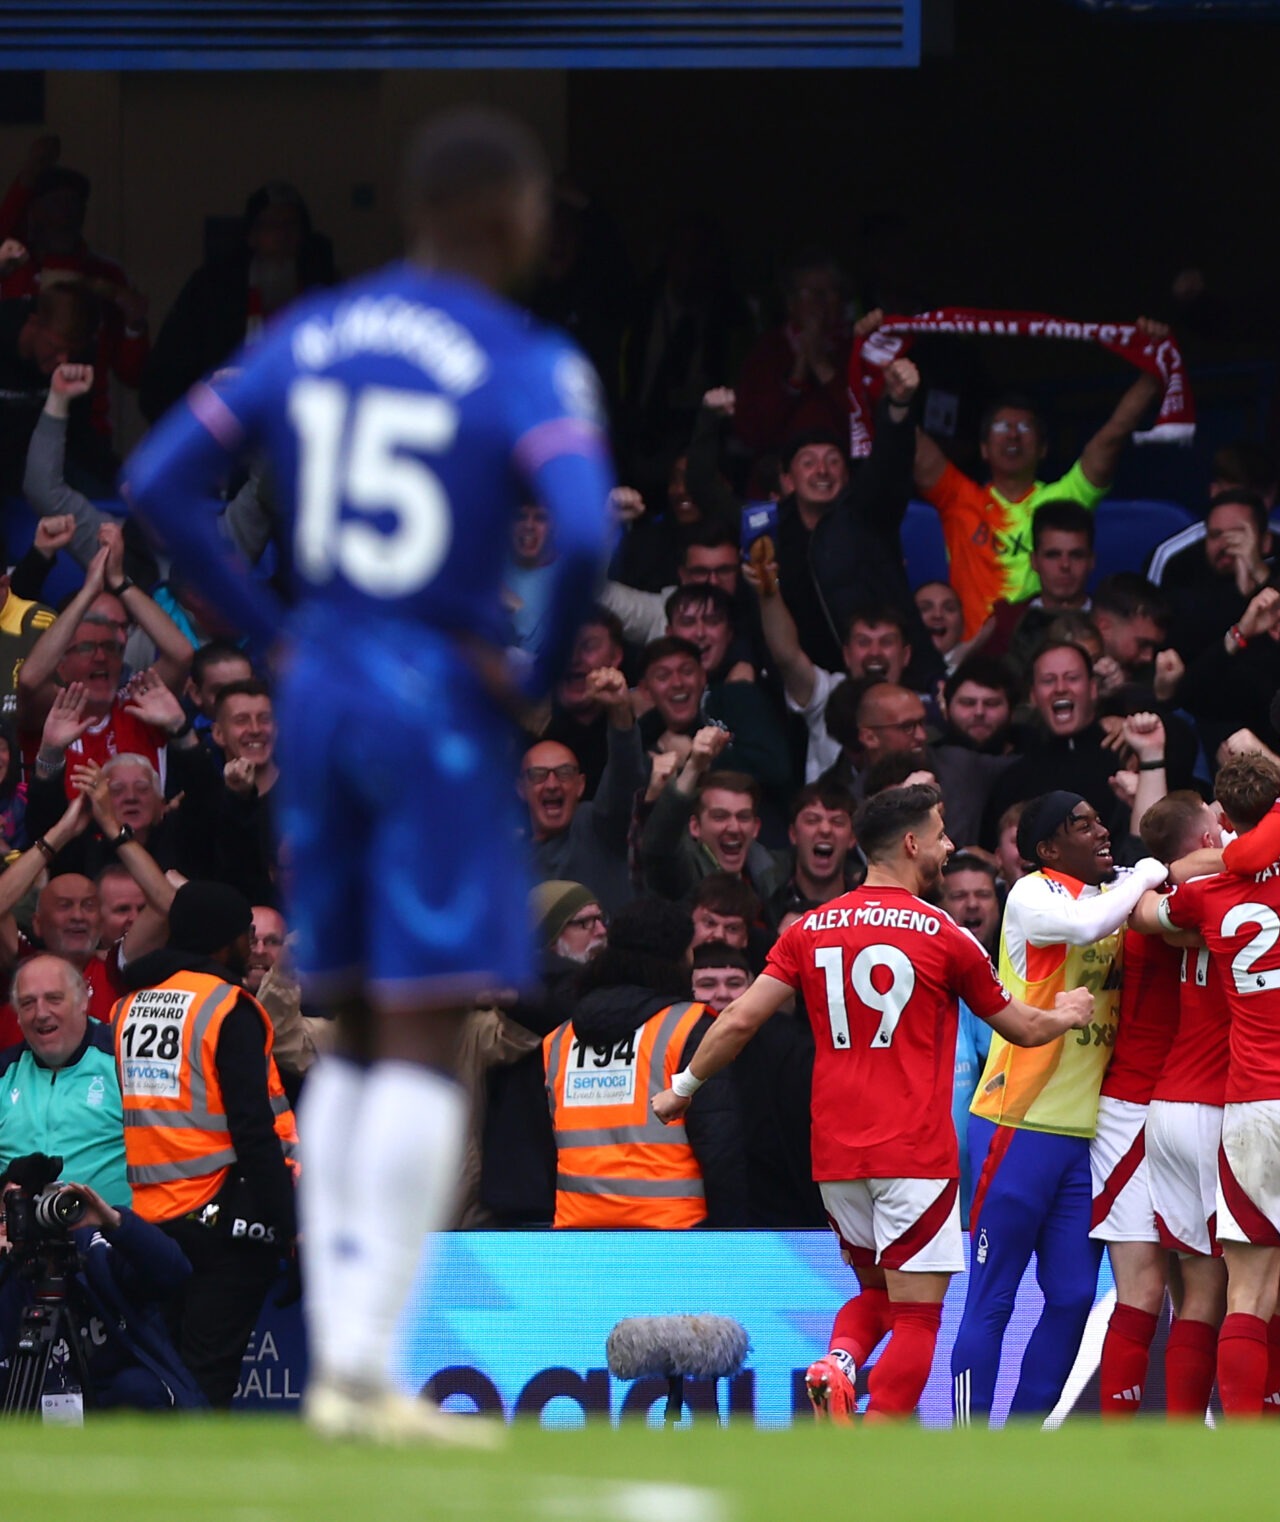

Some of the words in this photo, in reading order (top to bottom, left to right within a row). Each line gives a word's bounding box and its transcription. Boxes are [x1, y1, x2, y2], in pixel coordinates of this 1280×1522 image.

[288, 380, 457, 598] 15
[803, 909, 853, 931] ALEX
[854, 907, 941, 936] MORENO
[135, 991, 189, 1005] SUPPORT
[815, 944, 916, 1049] 19
[129, 1006, 184, 1020] STEWARD
[122, 1022, 180, 1060] 128
[572, 1031, 636, 1068] 194
[574, 1075, 626, 1089] servoca
[233, 1368, 301, 1399] ALL
